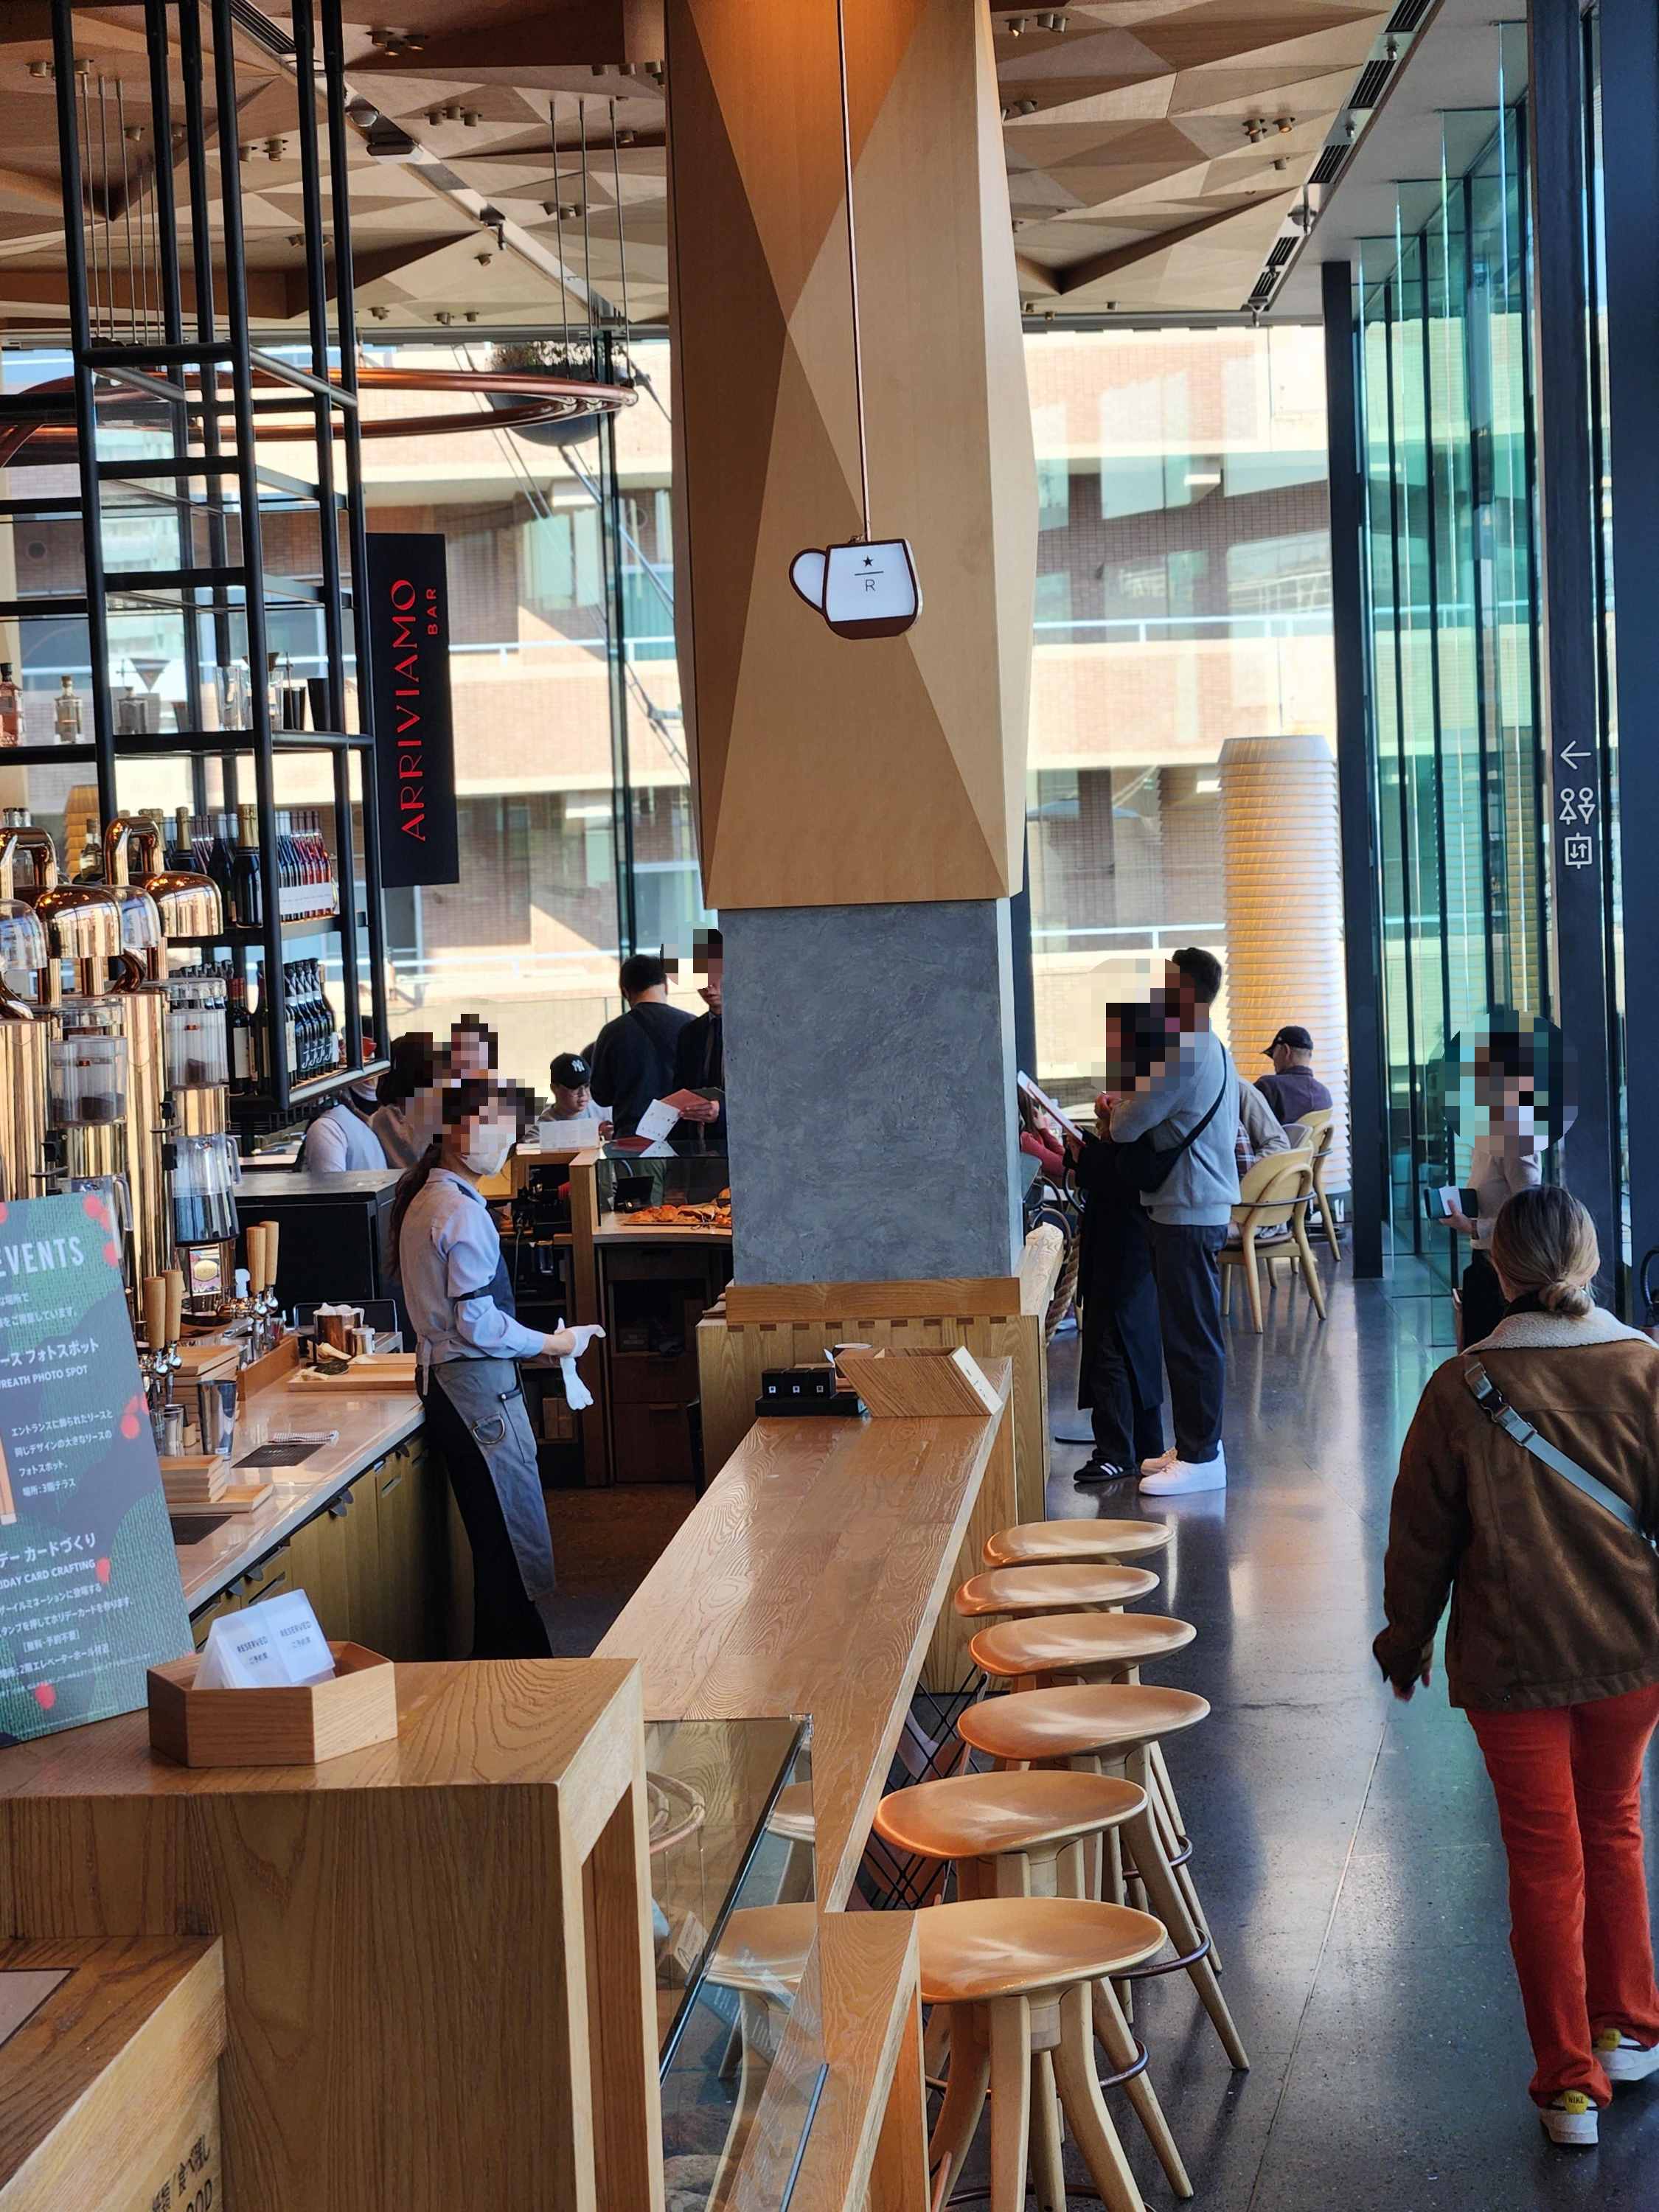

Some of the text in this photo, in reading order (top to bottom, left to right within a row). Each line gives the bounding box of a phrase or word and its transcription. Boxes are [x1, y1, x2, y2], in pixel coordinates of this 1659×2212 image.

[865, 579, 876, 592] R
[425, 588, 438, 635] BAR
[391, 580, 425, 841] ARRIVIAMO
[25, 1338, 99, 1363] フォトスポット
[0, 1365, 88, 1389] REATH PHOTO SPOT
[14, 1430, 112, 1458] 同じデザインの大きなリースの
[24, 1532, 96, 1562] カードづくり
[0, 1559, 96, 1590] IDAY CARD CRAFTING
[0, 1596, 133, 1638] タンプを押してホリデーカードを作ります。
[279, 1621, 311, 1637] RESERVED
[237, 1636, 268, 1652] RESERVED
[1568, 2096, 1585, 2104] NIKE
